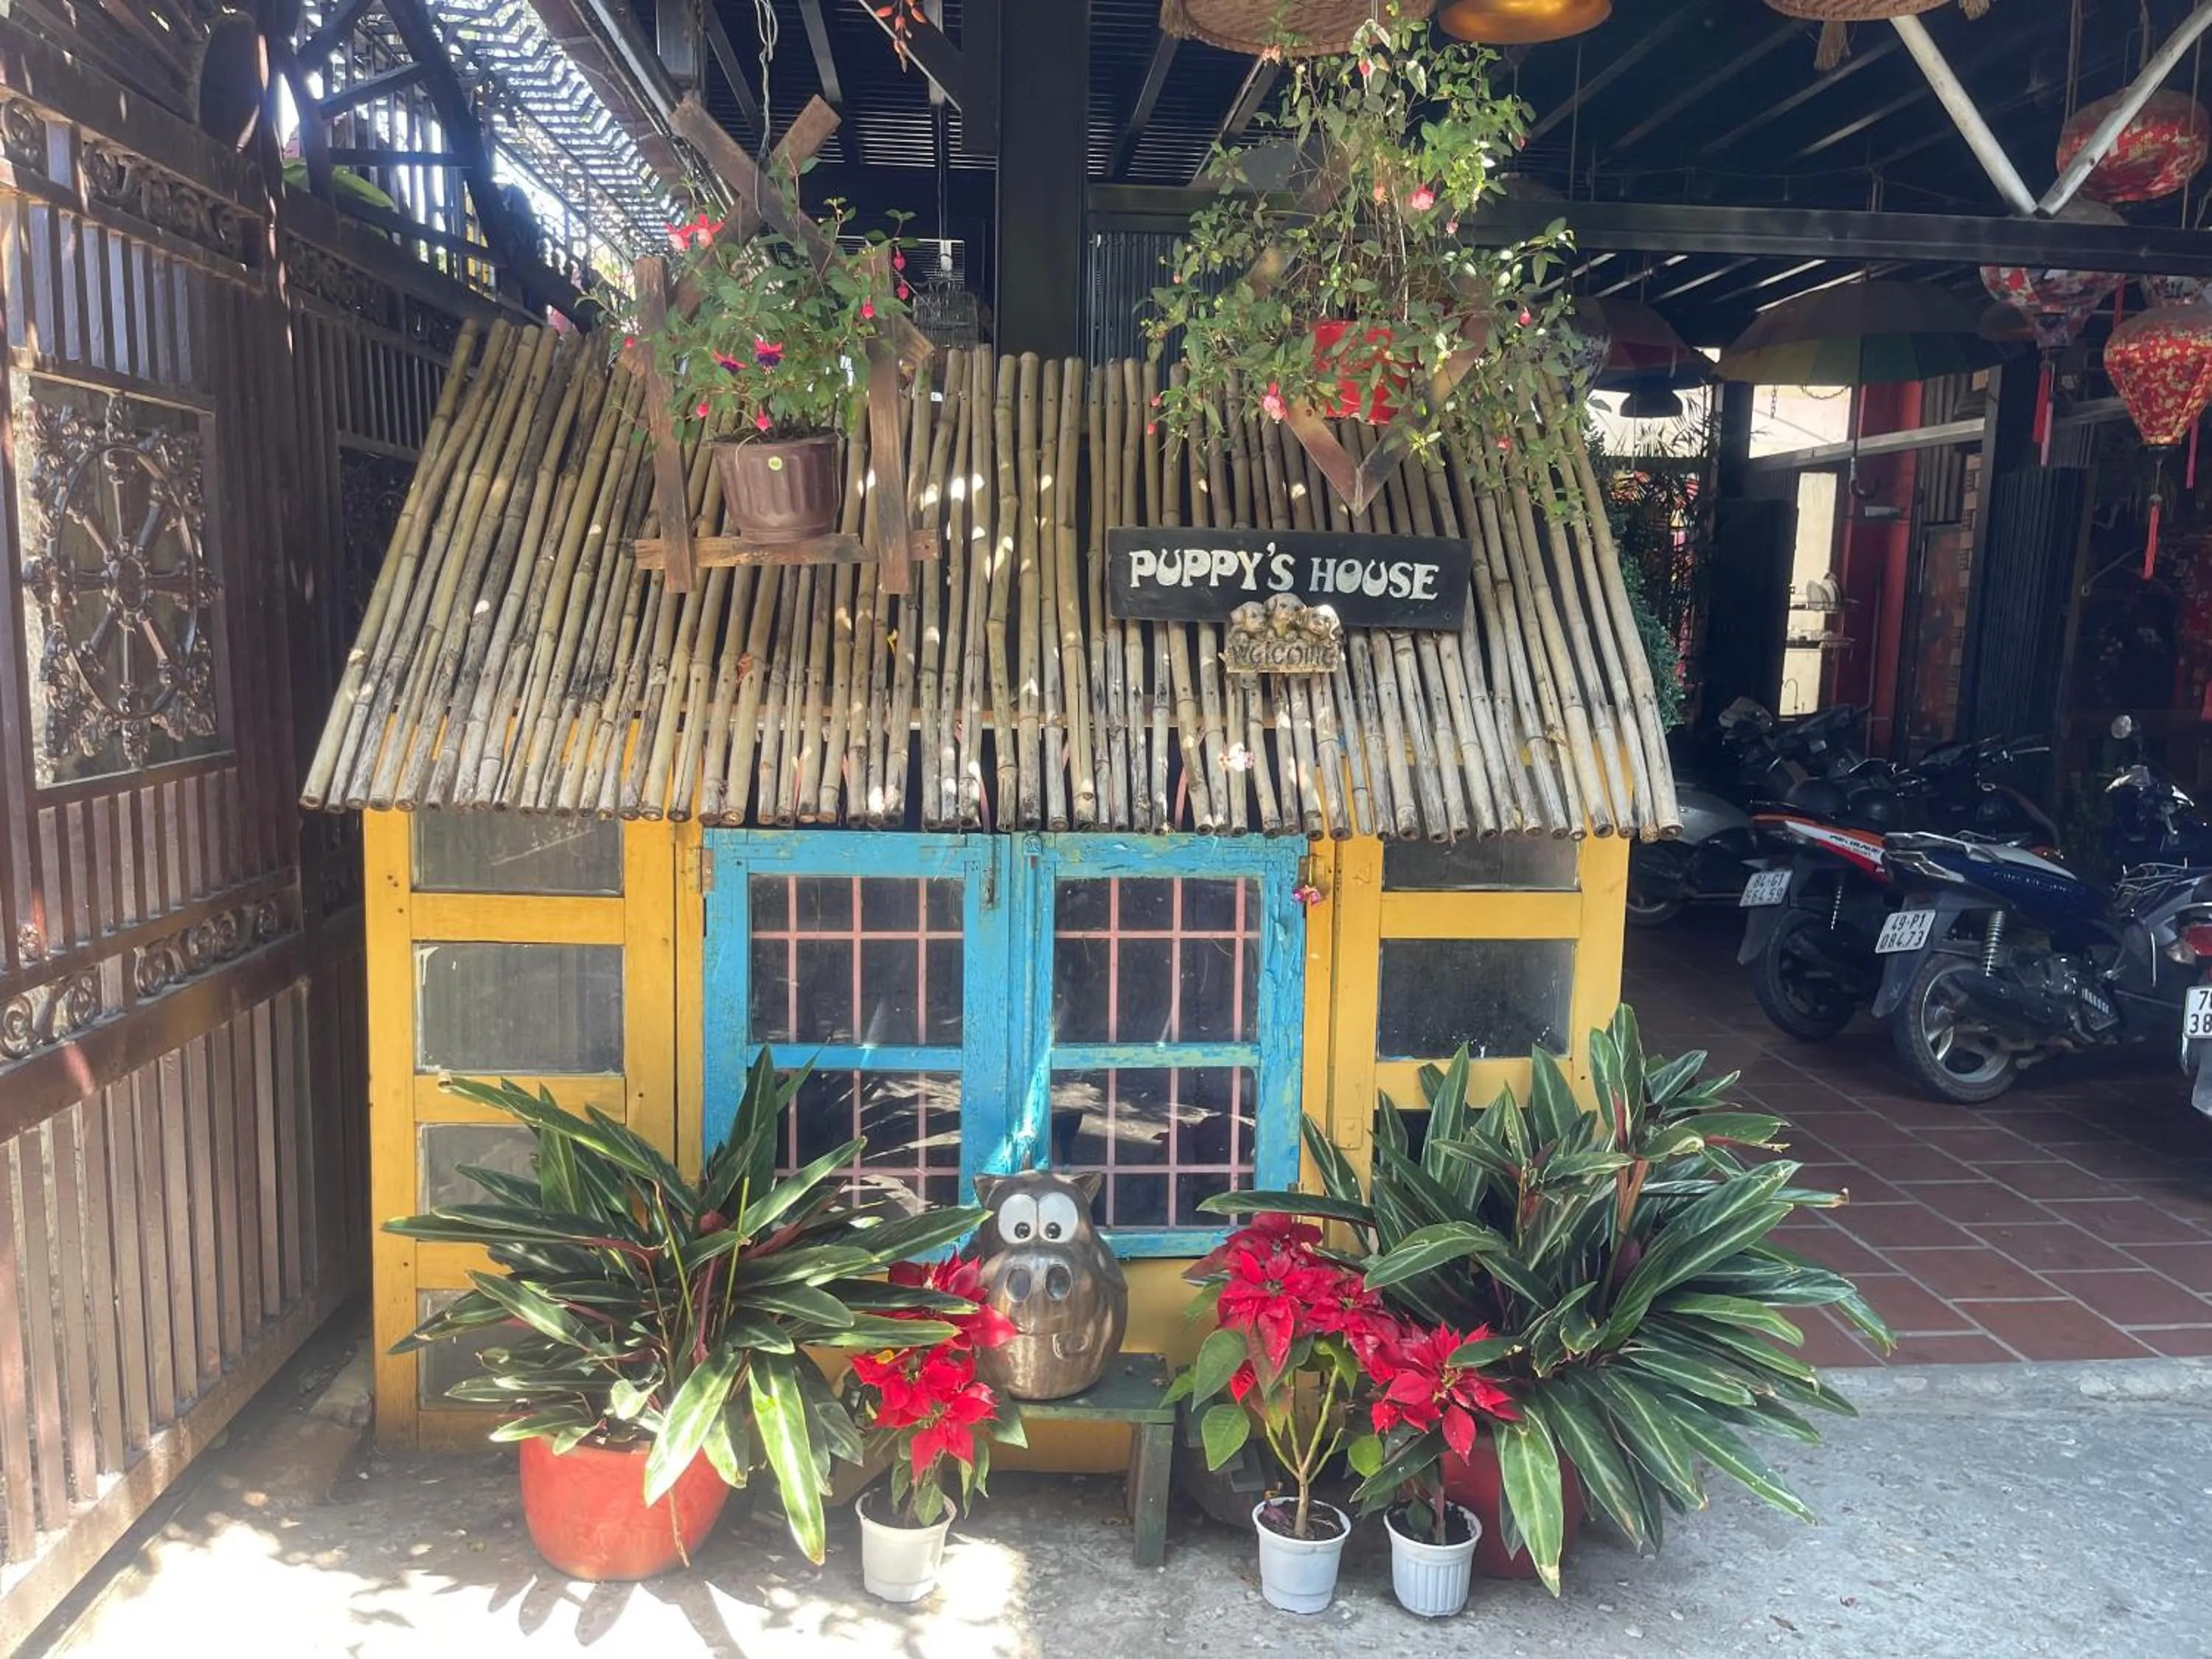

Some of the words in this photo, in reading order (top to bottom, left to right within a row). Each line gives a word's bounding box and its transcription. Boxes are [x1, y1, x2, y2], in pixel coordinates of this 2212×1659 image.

[1129, 542, 1295, 591] PUPPY'S
[1309, 557, 1439, 599] HOUSE
[2199, 990, 2212, 1011] 7
